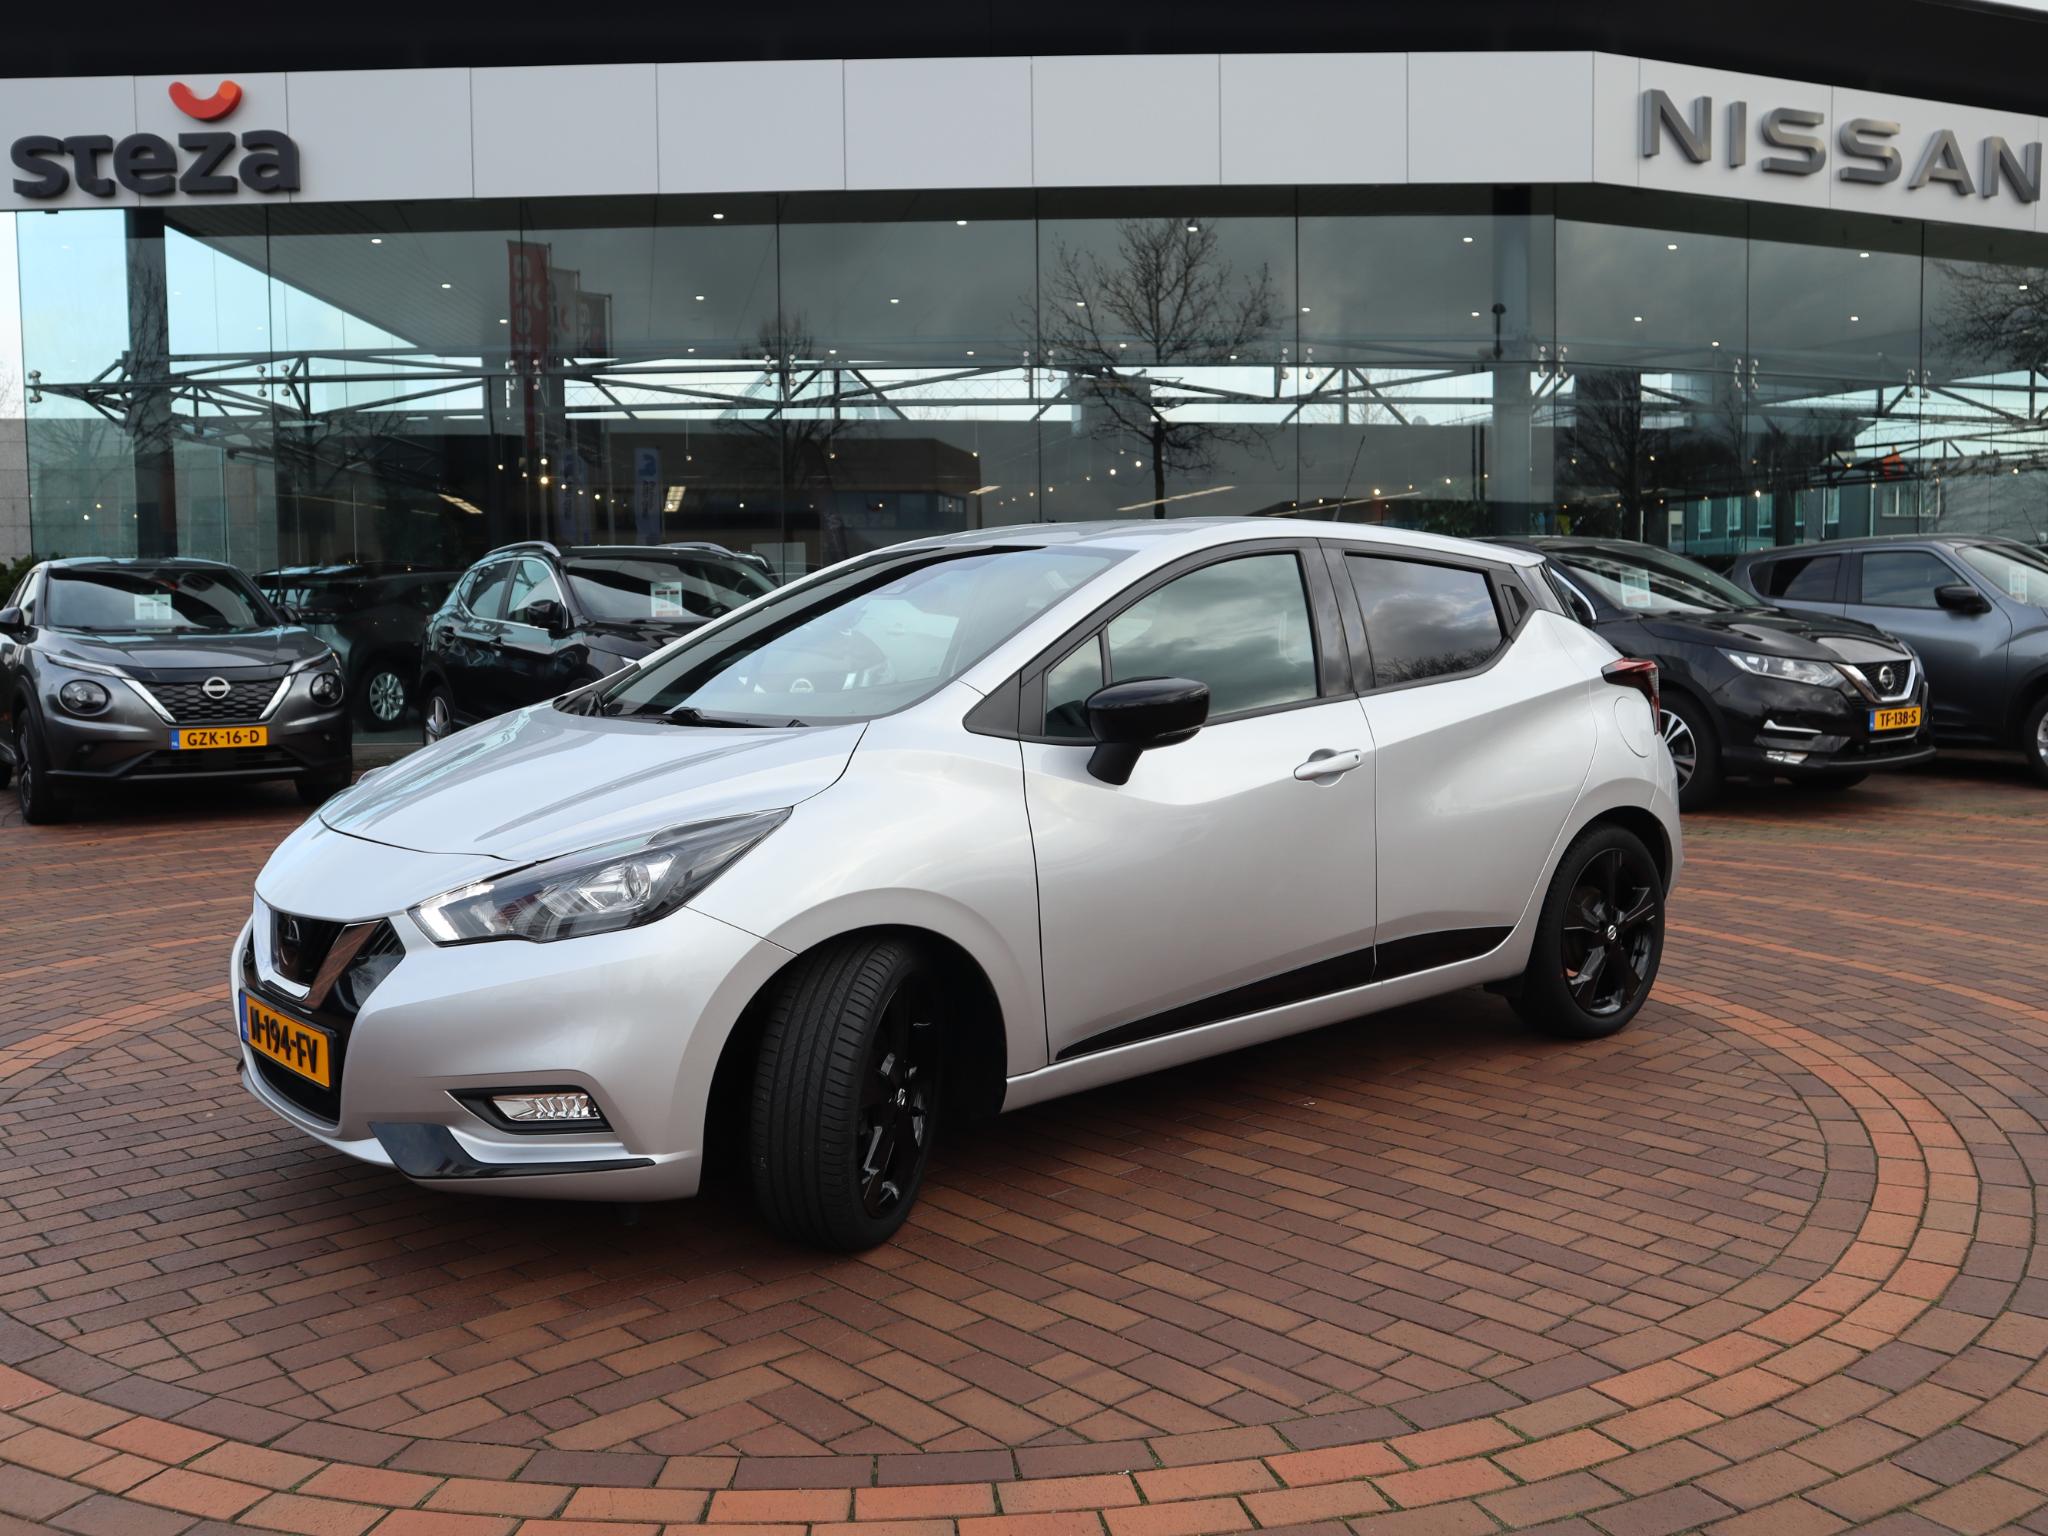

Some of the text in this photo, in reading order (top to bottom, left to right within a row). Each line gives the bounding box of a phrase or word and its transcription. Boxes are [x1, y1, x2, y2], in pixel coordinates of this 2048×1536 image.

[1642, 88, 2042, 204] NISSAN
[1880, 710, 1917, 727] TF-138-S
[187, 729, 260, 746] GZK-16-D
